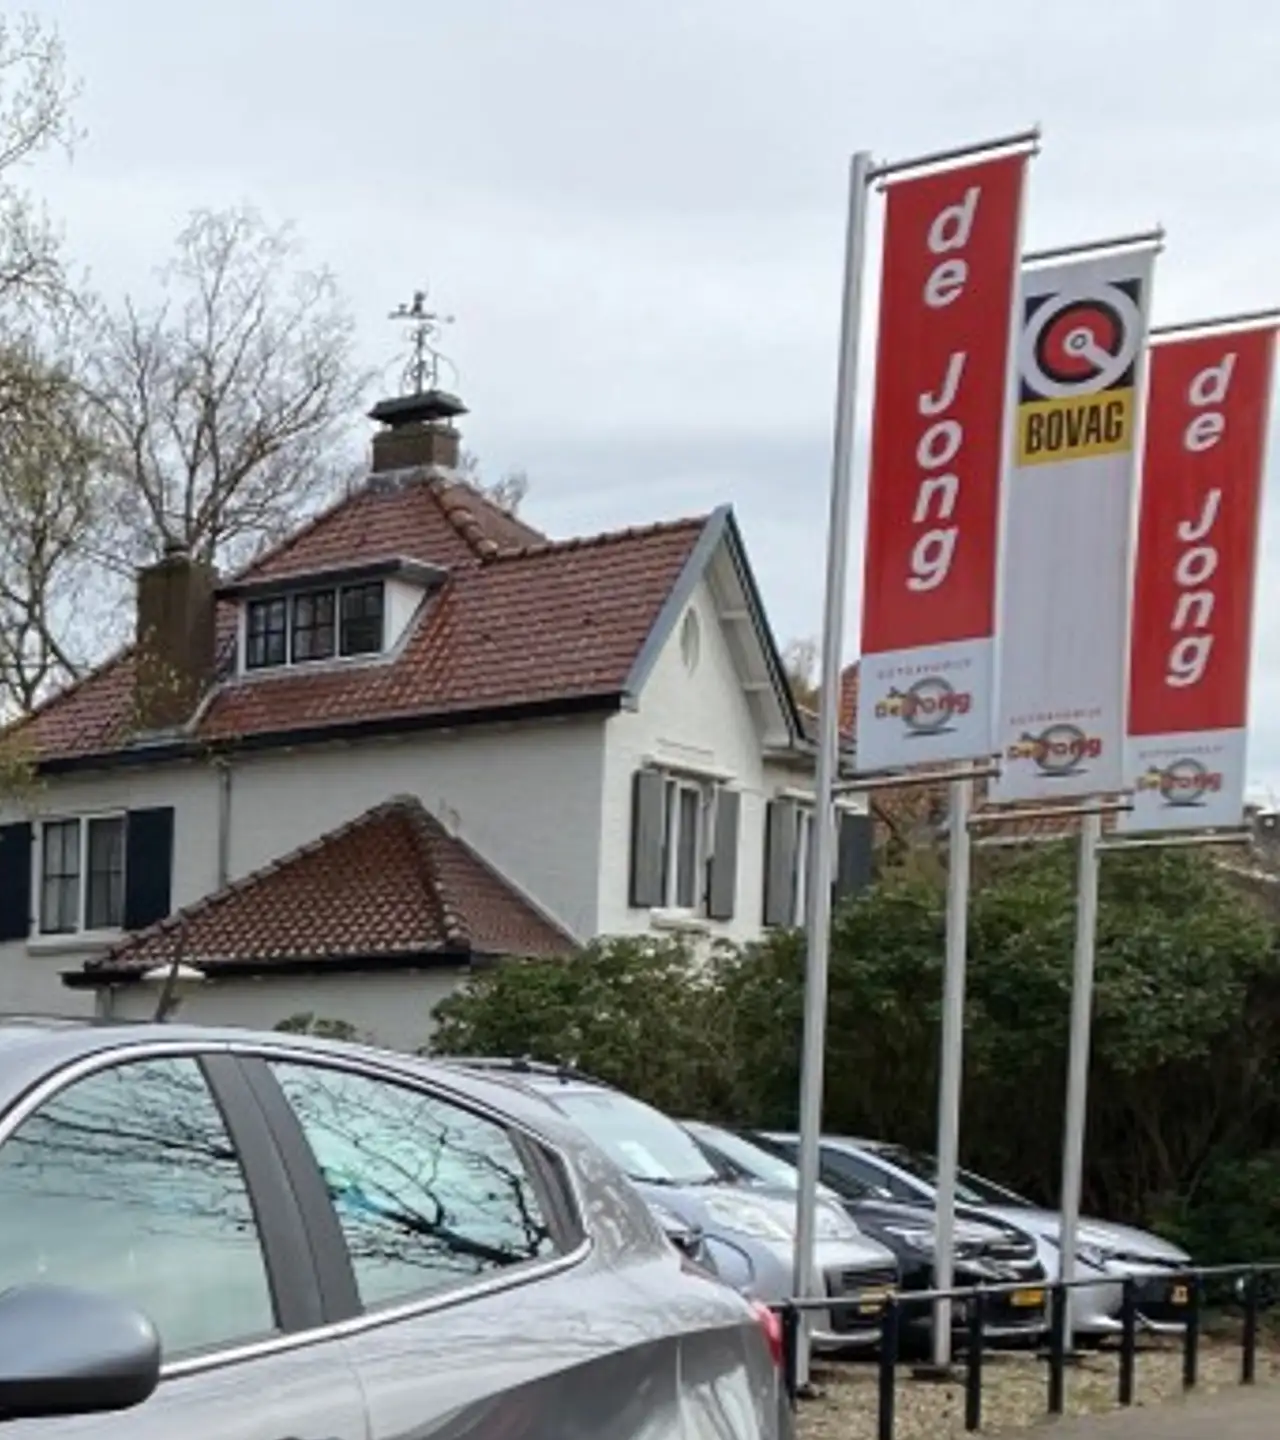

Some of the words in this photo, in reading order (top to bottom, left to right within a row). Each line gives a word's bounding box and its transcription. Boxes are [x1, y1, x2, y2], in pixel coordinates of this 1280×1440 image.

[924, 186, 981, 308] de
[1025, 400, 1124, 455] BOVAG
[1185, 352, 1238, 452] de
[906, 352, 967, 592] Jong
[1165, 488, 1222, 688] Jong
